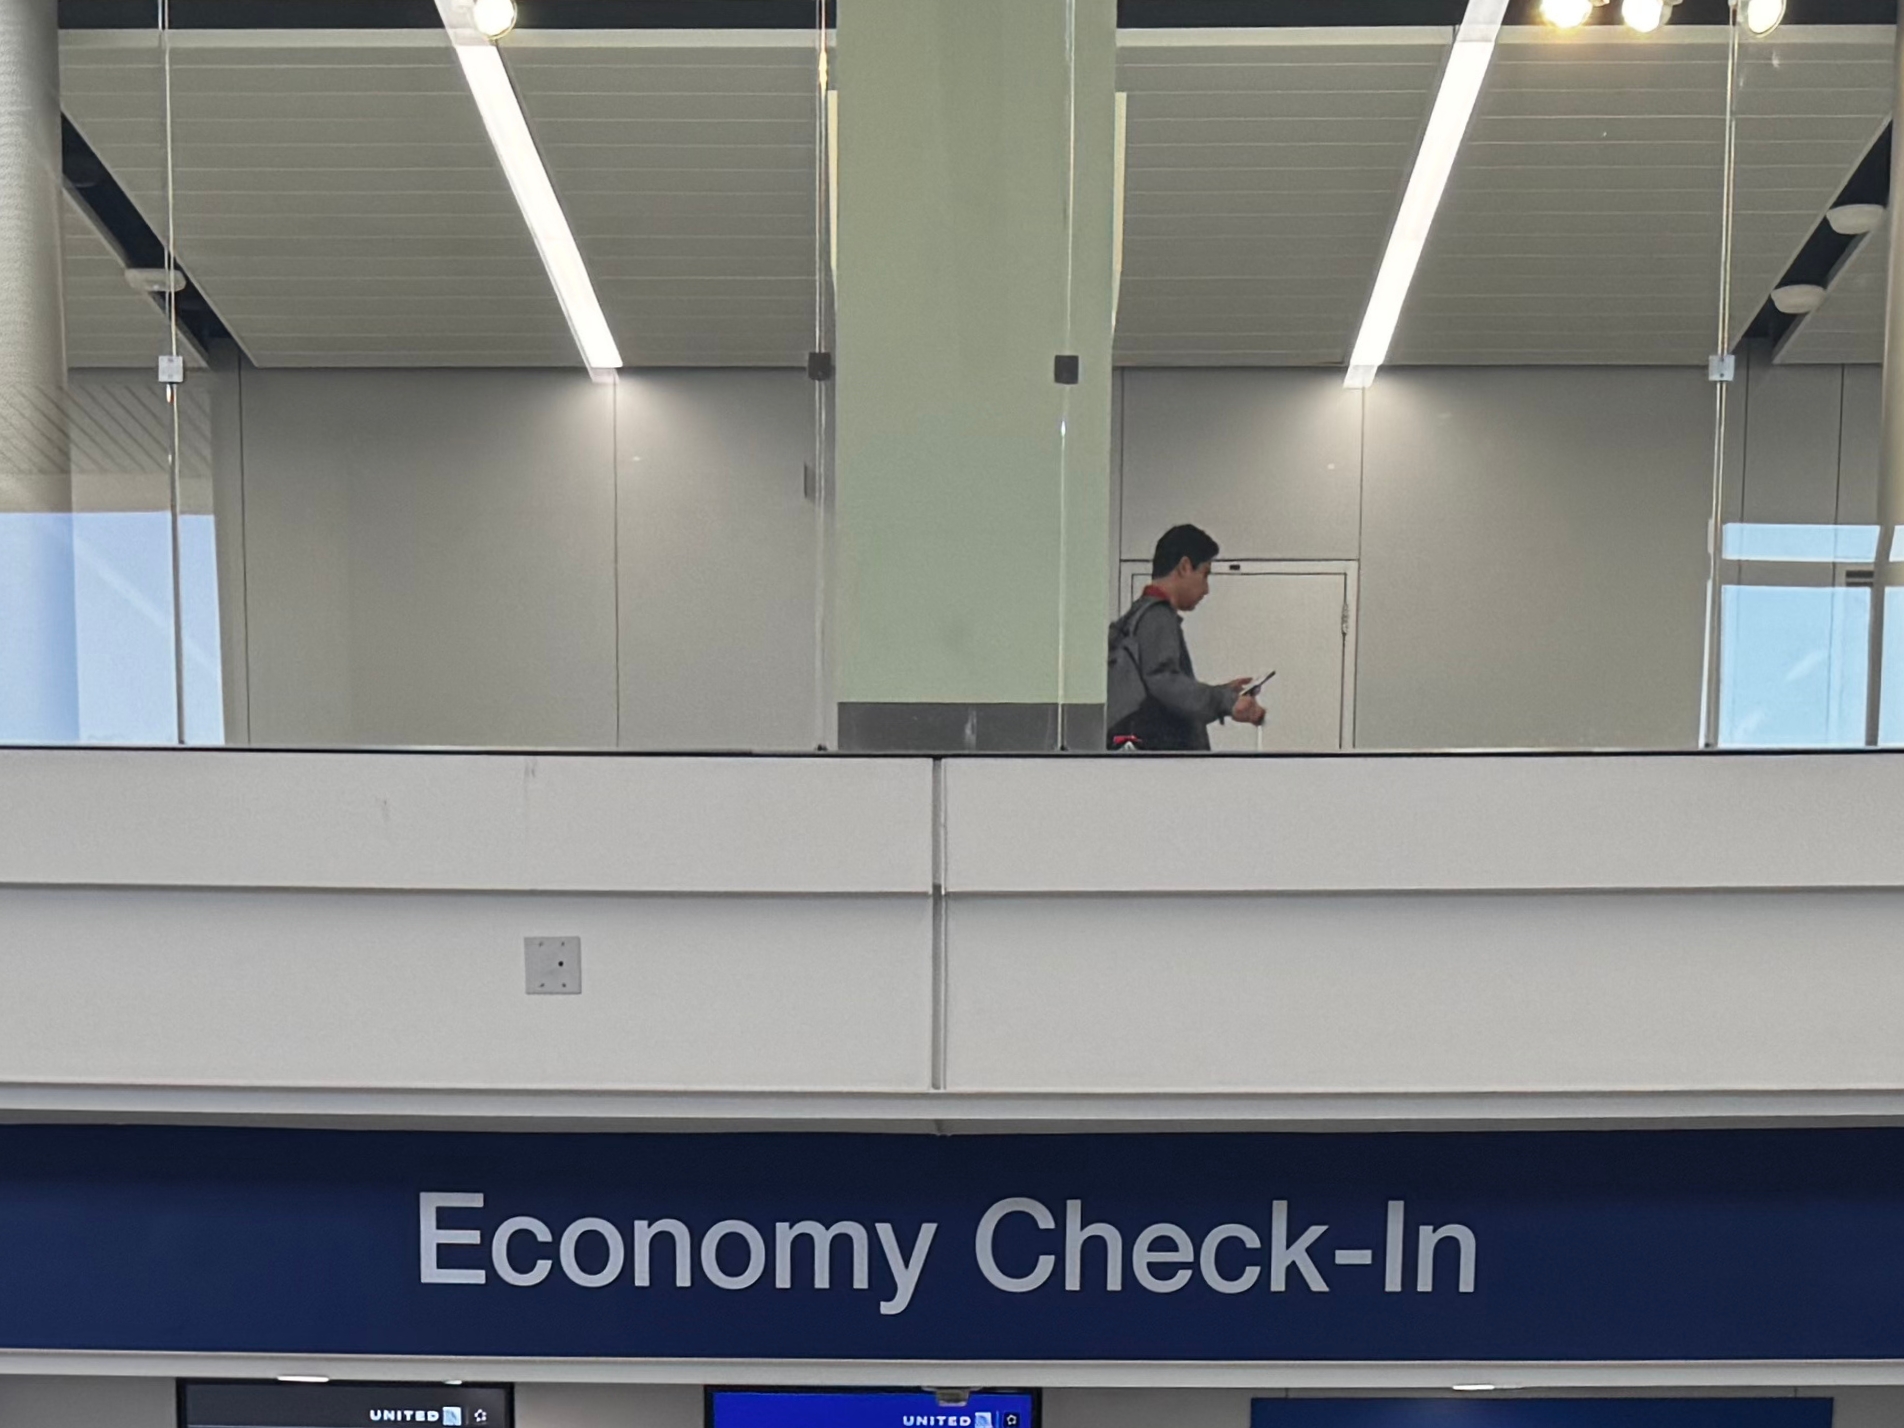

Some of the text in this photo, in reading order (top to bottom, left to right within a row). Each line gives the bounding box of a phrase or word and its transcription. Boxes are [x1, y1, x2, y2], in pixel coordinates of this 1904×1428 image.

[417, 1190, 1479, 1316] Economy Check-In
[369, 1409, 440, 1422] UNITED
[902, 1415, 972, 1427] UNITED
